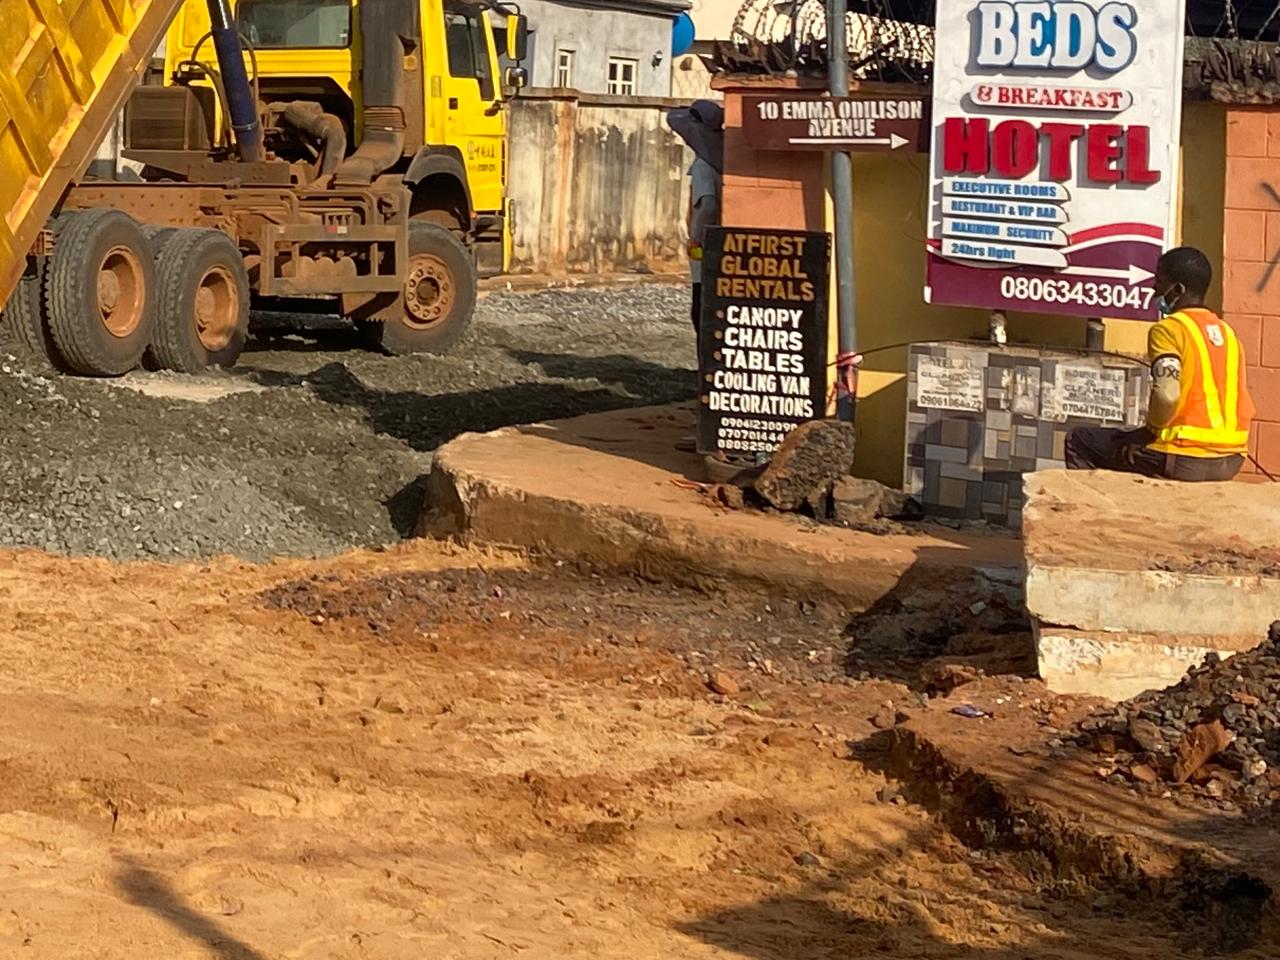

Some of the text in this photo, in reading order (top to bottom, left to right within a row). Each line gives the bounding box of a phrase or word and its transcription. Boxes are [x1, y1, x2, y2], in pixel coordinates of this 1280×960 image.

[976, 0, 1137, 72] BEDS
[977, 85, 1123, 109] & BREAKFAST
[756, 101, 779, 120] 10
[782, 101, 836, 120] EMMA
[808, 119, 876, 137] AVENUE
[943, 117, 1161, 185] HOTEL
[951, 181, 1057, 197] EXECUTIVE ROOMS
[951, 221, 1055, 241] MAXIMUM SECURITY
[723, 233, 807, 256] ATFIRST
[951, 242, 1016, 260] 24hrs light
[721, 255, 808, 279] GLOBAL
[716, 277, 815, 302] RENTALS
[1001, 276, 1156, 310] 08063433047
[726, 305, 803, 329] CANOPY
[724, 326, 803, 351] CHAIRS
[721, 348, 805, 374] TABLES
[714, 370, 810, 396] COOLING VAN
[709, 391, 814, 418] DECORATIONS
